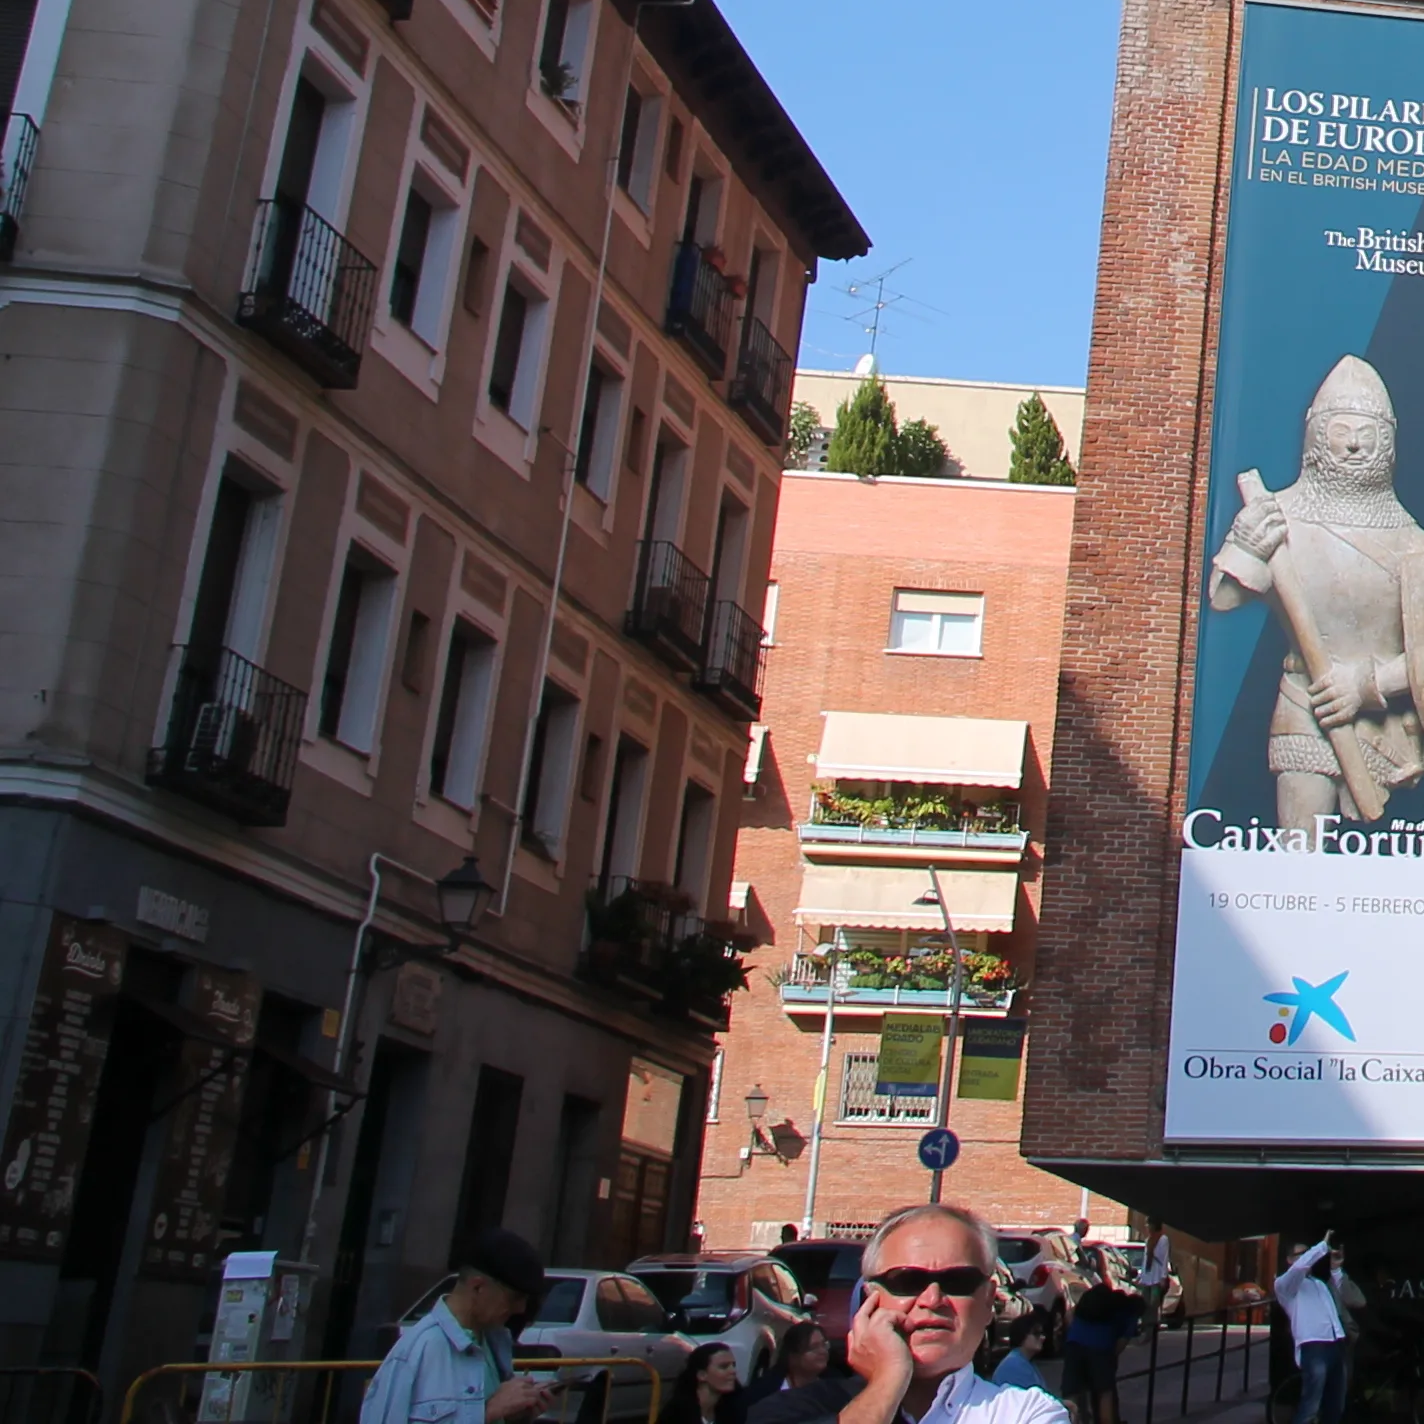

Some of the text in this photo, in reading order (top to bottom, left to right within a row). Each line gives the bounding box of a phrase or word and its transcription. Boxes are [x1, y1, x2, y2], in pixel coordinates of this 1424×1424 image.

[1264, 87, 1324, 117] LOS
[1261, 116, 1310, 146] DE
[1260, 146, 1293, 167] LA
[1301, 150, 1369, 174] EDAD
[1259, 168, 1284, 183] EN
[1286, 170, 1308, 186] EL
[1312, 173, 1377, 192] BRITISH
[1323, 229, 1356, 248] The
[1207, 892, 1230, 909] 19
[1234, 893, 1318, 912] OCTUBRE
[1335, 896, 1346, 912] 5
[1183, 1054, 1247, 1080] Obra
[1252, 1055, 1323, 1082] Social
